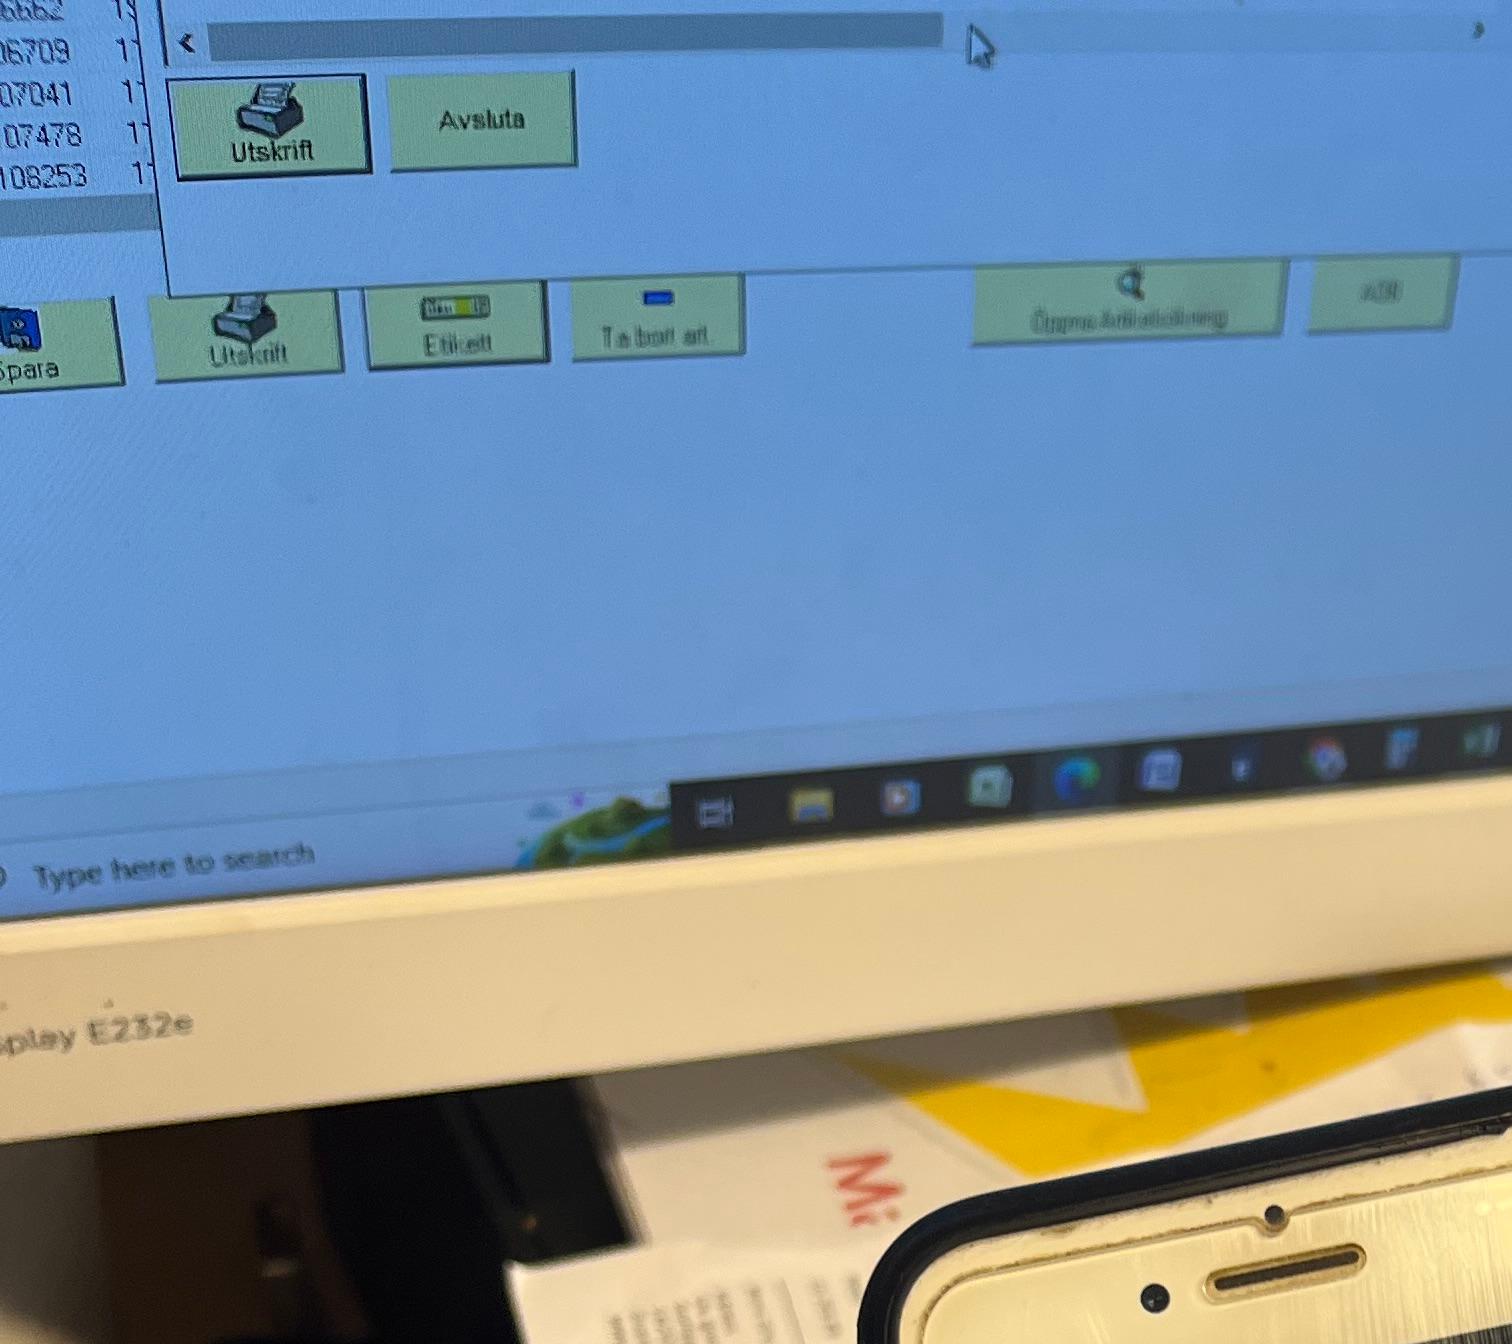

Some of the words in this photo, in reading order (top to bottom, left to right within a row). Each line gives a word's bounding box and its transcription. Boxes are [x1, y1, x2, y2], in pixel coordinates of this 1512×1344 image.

[438, 107, 526, 131] Avsluta
[230, 139, 314, 164] Utskrift
[208, 342, 289, 368] Utskrift
[33, 864, 103, 894] Type
[110, 857, 176, 881] here
[182, 852, 215, 876] to
[222, 844, 316, 873] search
[87, 1011, 194, 1047] E232e
